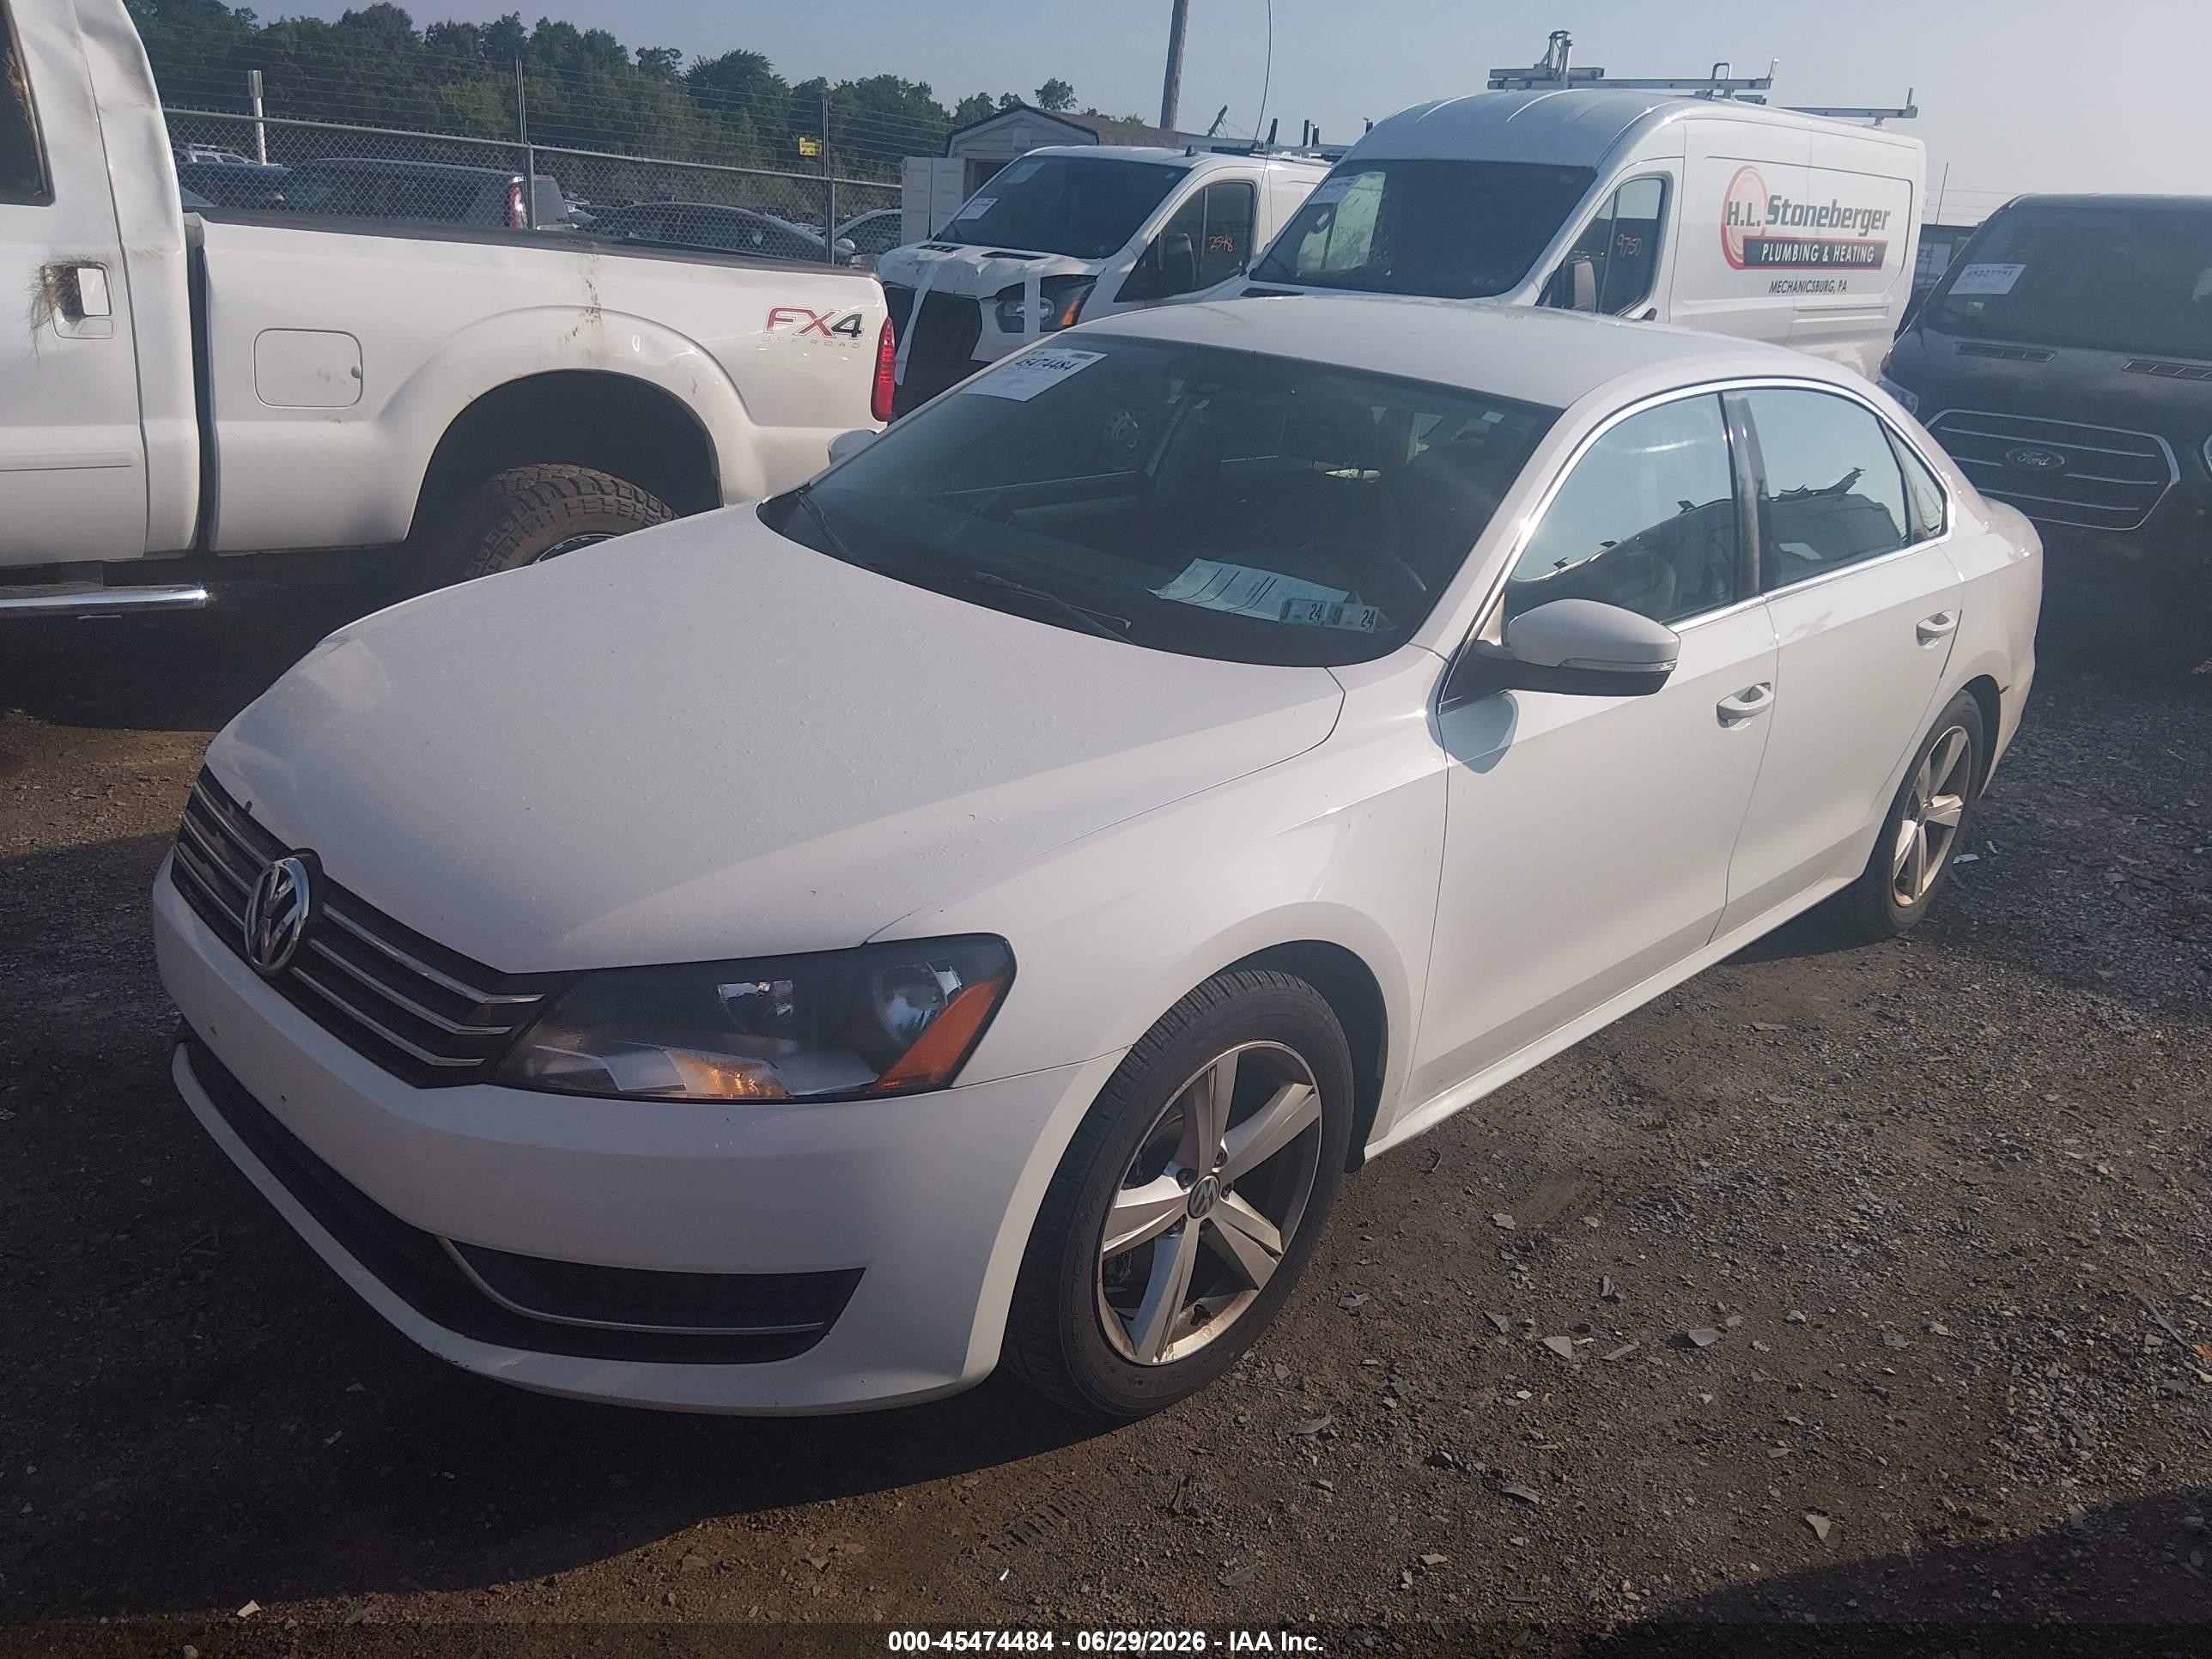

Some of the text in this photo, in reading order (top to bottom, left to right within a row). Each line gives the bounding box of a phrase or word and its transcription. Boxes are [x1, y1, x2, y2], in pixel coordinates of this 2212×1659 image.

[1726, 194, 1891, 237] H.L. Stoneberger
[1209, 234, 1233, 252] 2548
[1617, 233, 1642, 257] 9750
[1761, 243, 1875, 263] PLUMBING & HEATING
[1769, 280, 1847, 294] MECHANICSBURG, PA
[764, 306, 864, 340] FX4
[1308, 603, 1324, 621] 24
[1360, 610, 1376, 629] 24
